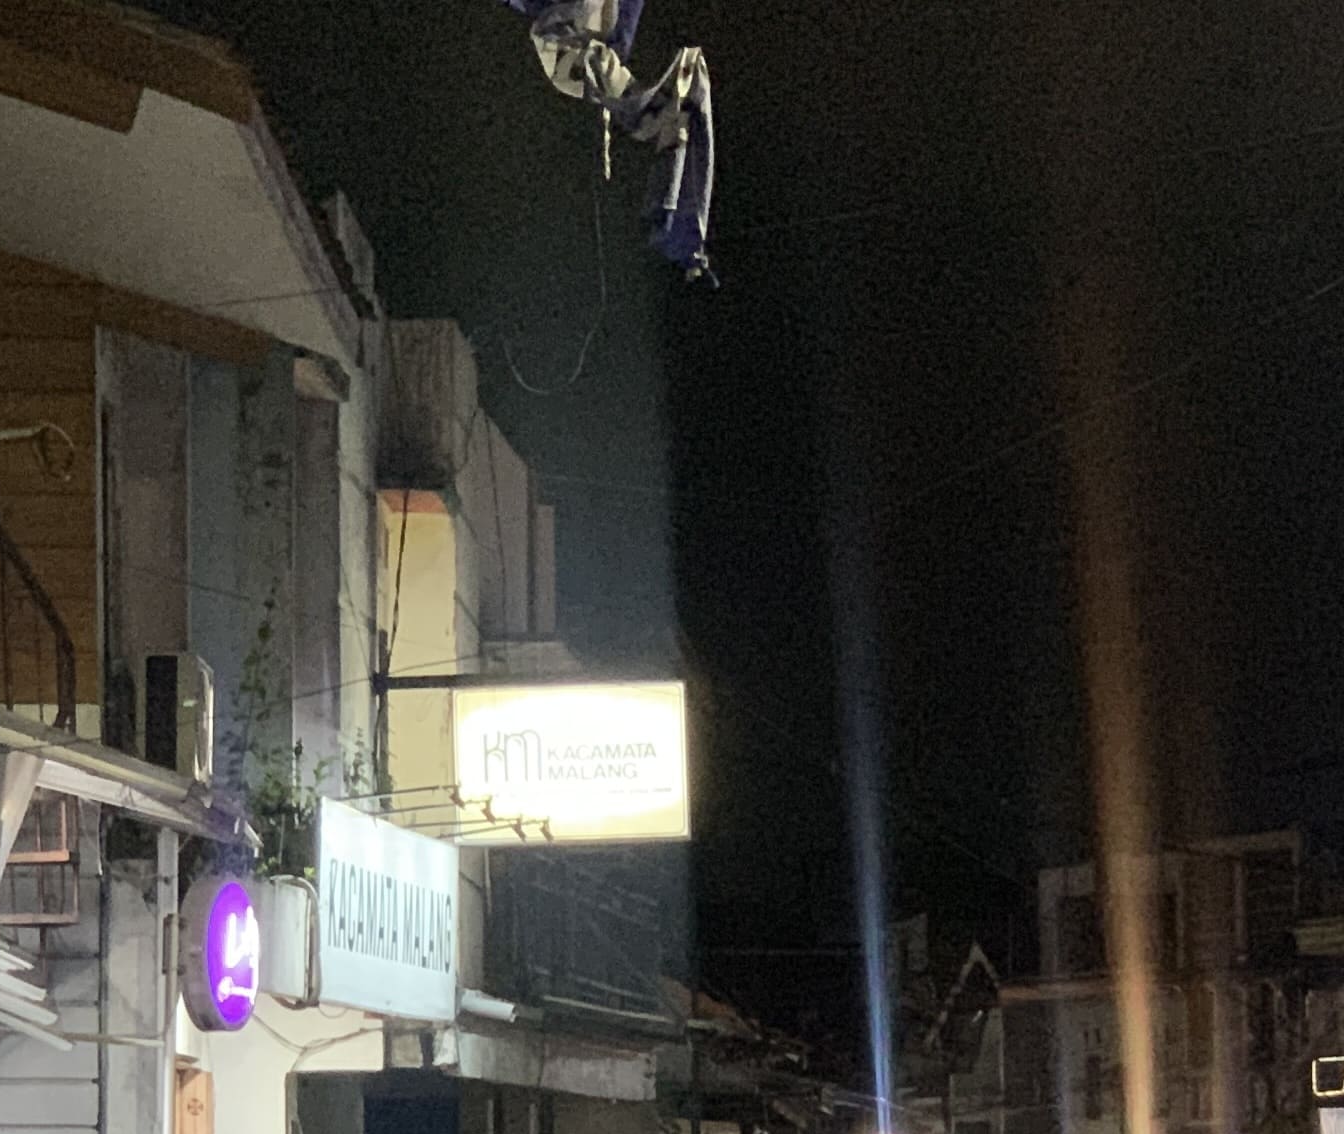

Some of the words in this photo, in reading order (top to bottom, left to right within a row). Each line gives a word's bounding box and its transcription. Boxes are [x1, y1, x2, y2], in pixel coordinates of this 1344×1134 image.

[547, 742, 656, 761] KACAMATA
[548, 762, 638, 781] MALANG
[327, 857, 398, 962] KACAMATA
[402, 881, 452, 975] MALANG
